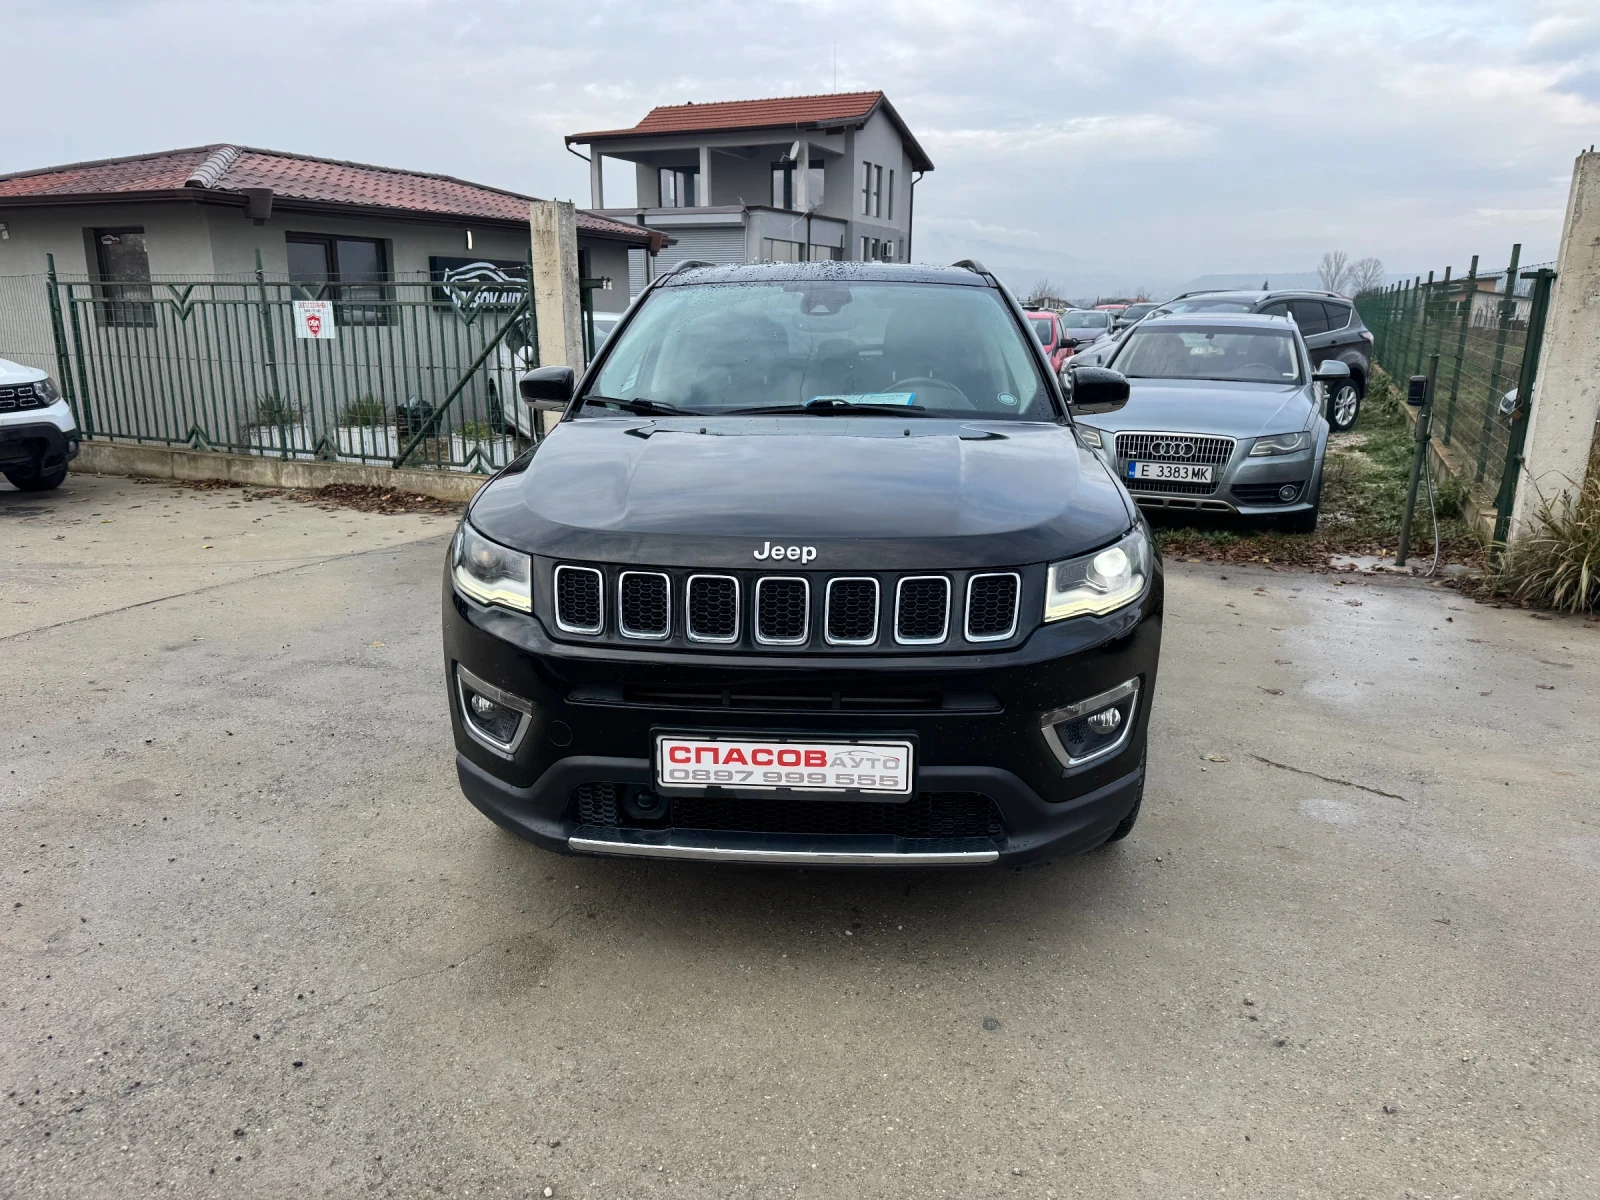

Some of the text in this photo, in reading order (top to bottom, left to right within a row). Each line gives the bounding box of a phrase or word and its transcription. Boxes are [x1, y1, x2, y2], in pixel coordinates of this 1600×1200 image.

[500, 291, 528, 309] AUT
[1141, 464, 1150, 477] E
[1156, 465, 1189, 479] 3383
[1191, 467, 1209, 481] MK
[753, 541, 817, 564] Jeep
[668, 745, 828, 768] СПАСОВ
[668, 768, 900, 788] 0897 999 555
